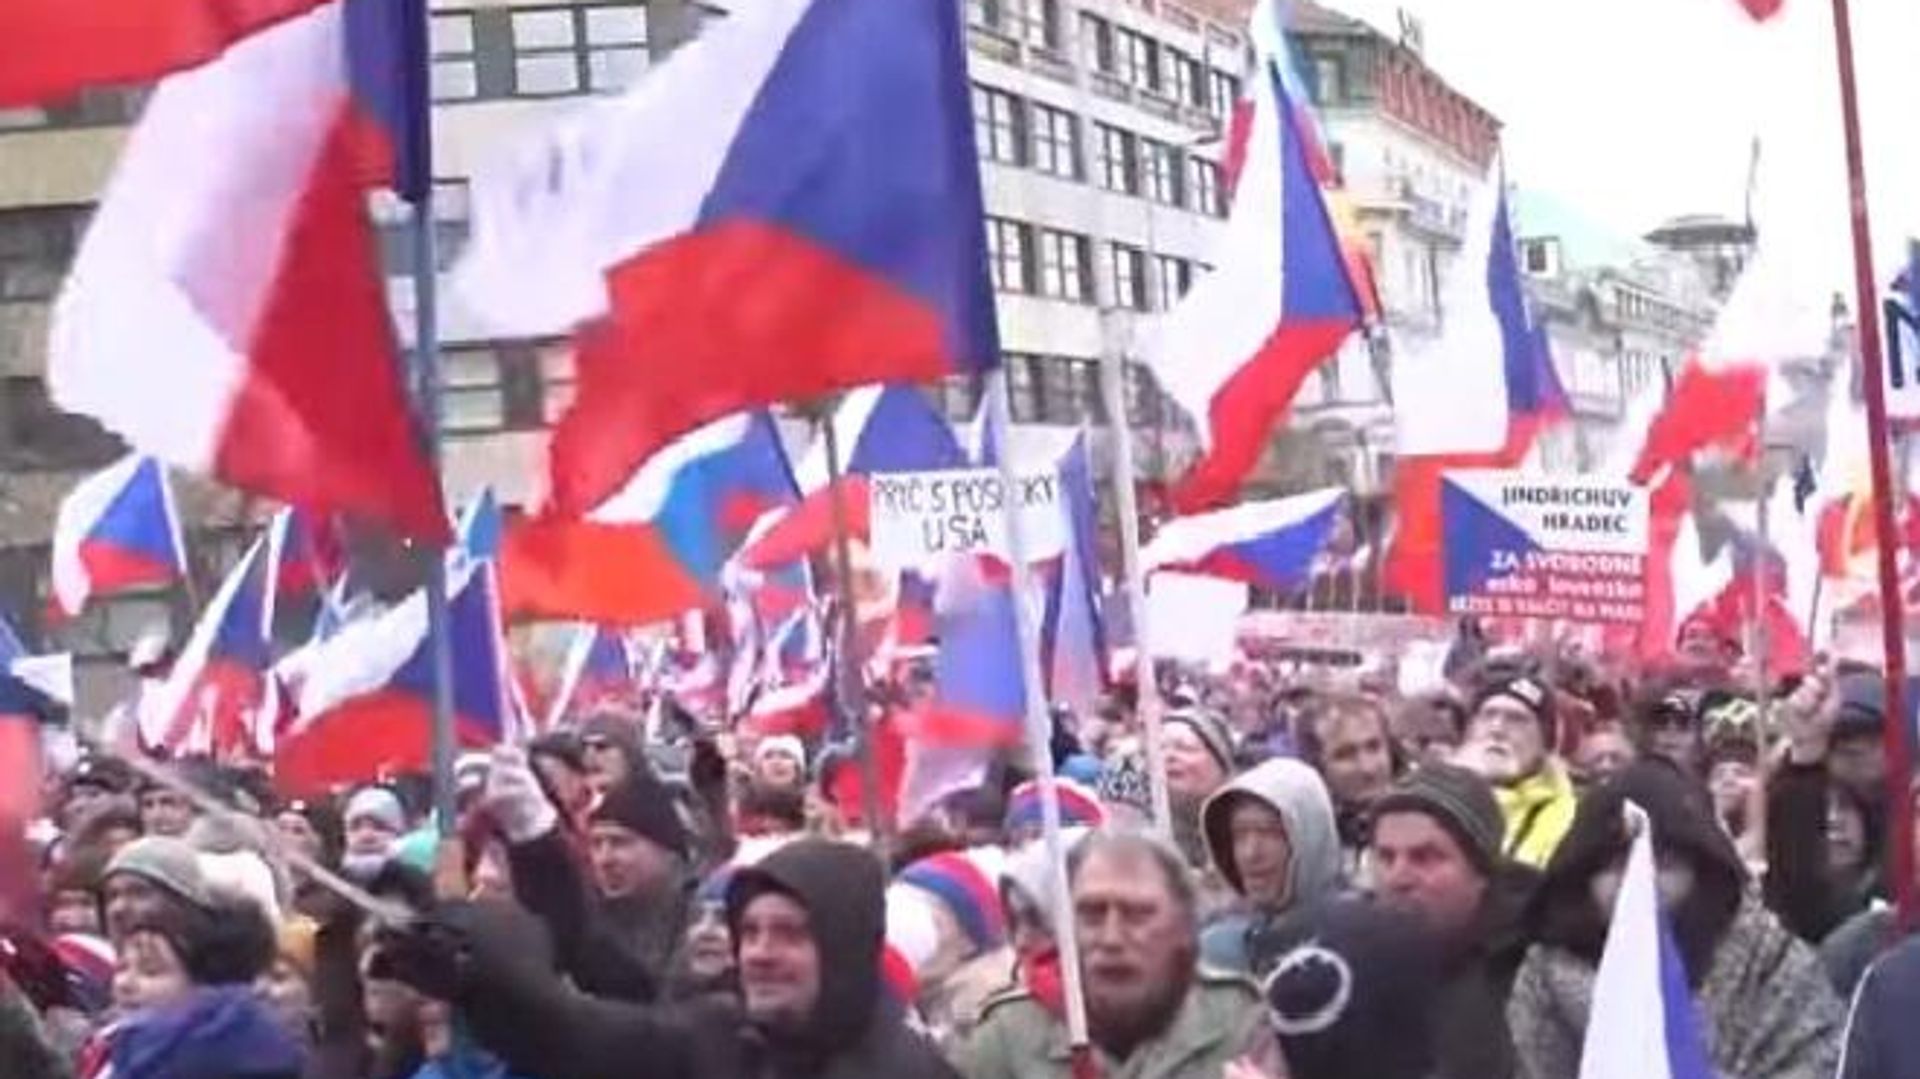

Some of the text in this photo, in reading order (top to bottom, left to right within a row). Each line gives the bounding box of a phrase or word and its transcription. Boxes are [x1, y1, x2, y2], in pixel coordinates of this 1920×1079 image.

[1542, 512, 1630, 533] HRADEC
[921, 513, 990, 554] USA
[1489, 549, 1520, 570] ZA
